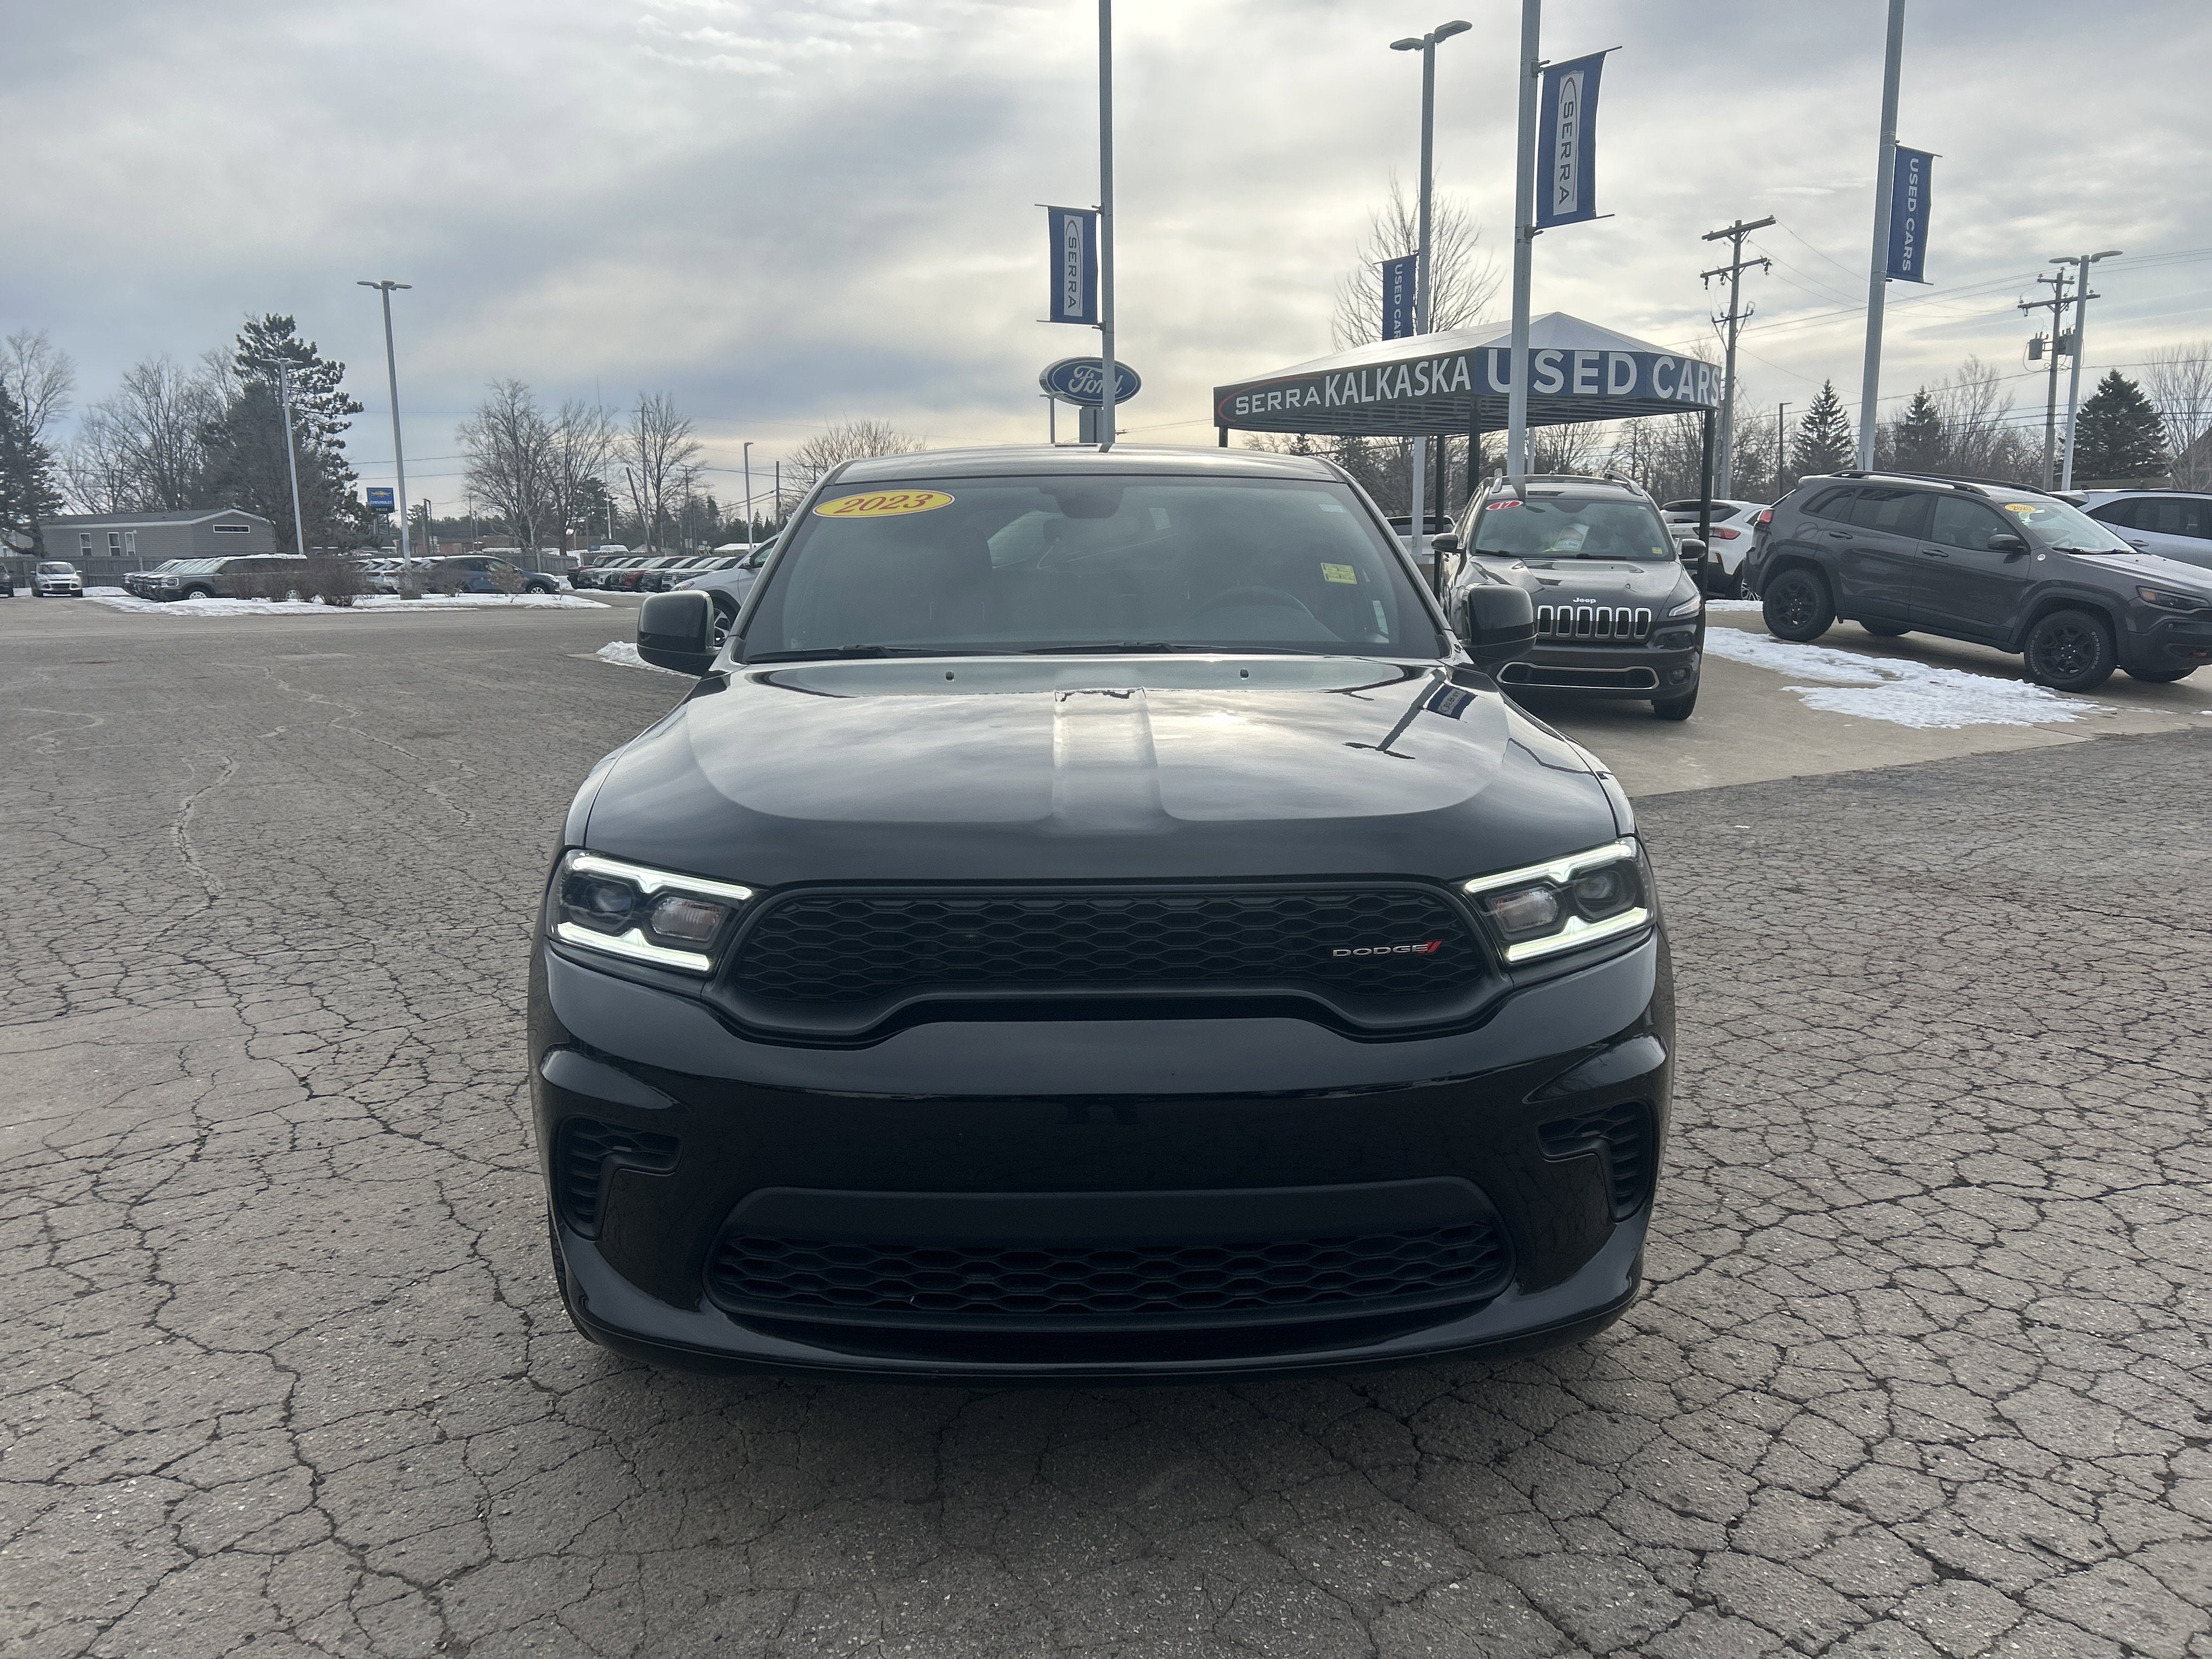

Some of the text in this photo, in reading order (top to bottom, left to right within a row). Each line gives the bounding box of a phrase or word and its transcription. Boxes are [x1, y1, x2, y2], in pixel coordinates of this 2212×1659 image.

[1559, 100, 1573, 205] SERRA
[1902, 157, 1919, 272] USED CARS
[1068, 236, 1077, 308] SERRA
[1395, 263, 1403, 305] USED
[1235, 356, 1471, 415] SERRA KALKASKA
[1487, 349, 1720, 408] USED CARS
[833, 494, 934, 515] 2023
[1332, 943, 1429, 957] DODGE
